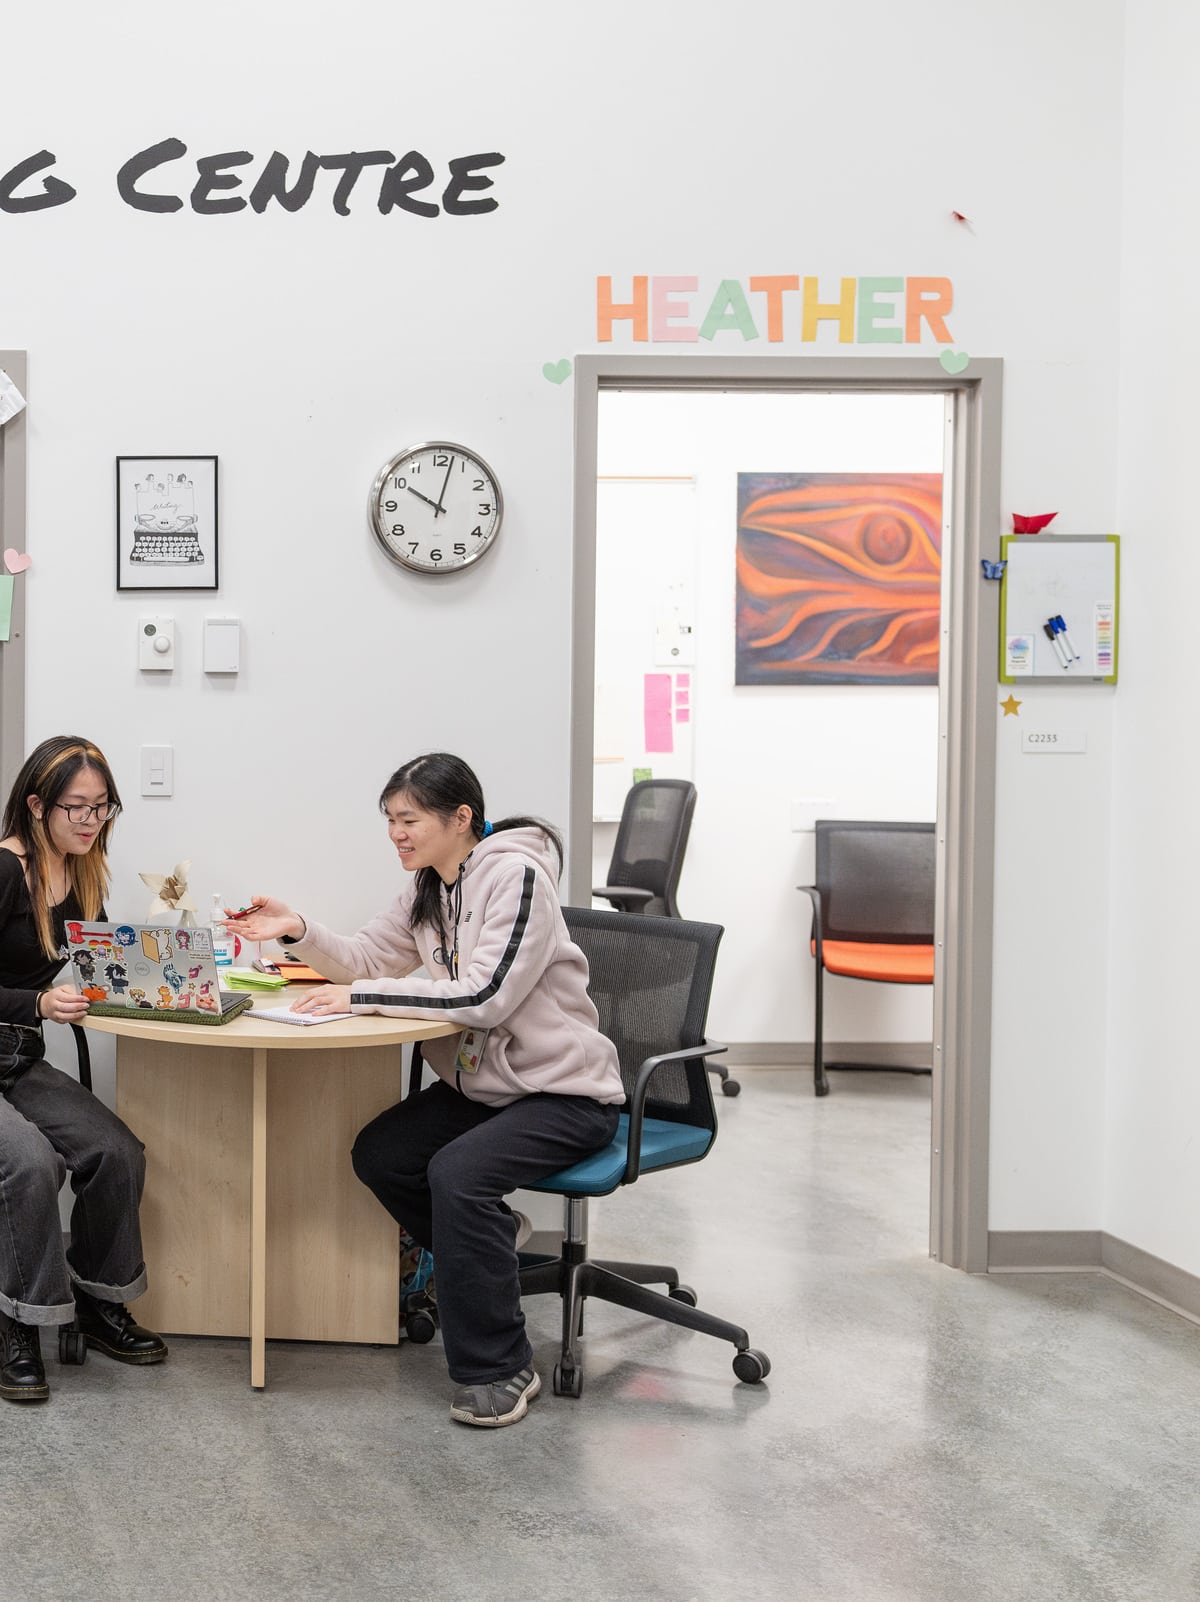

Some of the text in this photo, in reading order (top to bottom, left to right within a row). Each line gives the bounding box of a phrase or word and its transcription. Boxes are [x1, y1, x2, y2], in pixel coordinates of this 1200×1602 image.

[117, 137, 505, 218] CENTRE
[596, 275, 954, 344] HEATHER
[433, 455, 448, 466] 12
[395, 477, 406, 489] 10
[472, 480, 484, 491] 2
[385, 500, 397, 512] 9
[478, 503, 490, 515] 3
[392, 524, 405, 536] 8
[471, 526, 482, 538] 4
[408, 542, 419, 554] 7
[454, 543, 466, 555] 5
[430, 549, 442, 561] 6
[1028, 734, 1057, 743] C2233
